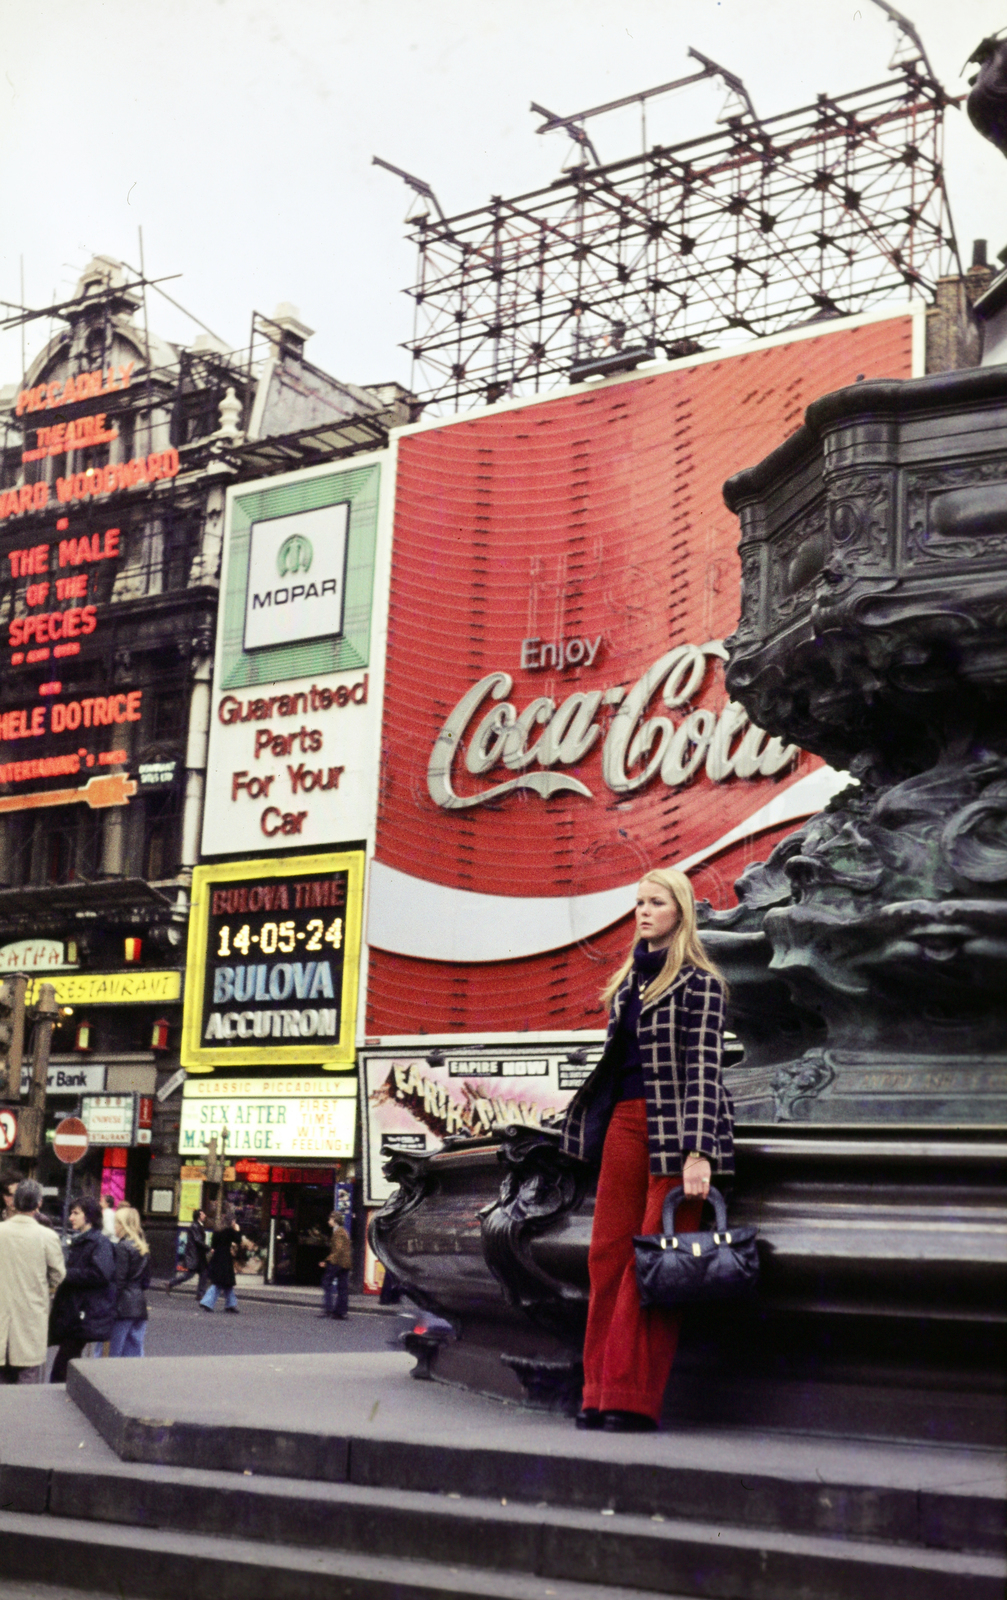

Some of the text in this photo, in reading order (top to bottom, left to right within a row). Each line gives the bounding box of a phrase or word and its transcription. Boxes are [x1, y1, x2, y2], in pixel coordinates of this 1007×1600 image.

[16, 361, 134, 416] PICCADILLY
[36, 413, 107, 449] THEATRE
[56, 448, 179, 504] WOODWARD
[8, 528, 120, 578] THE MALE
[26, 573, 88, 607] OF THE
[251, 578, 338, 609] MOPAR
[8, 605, 97, 647] SPECIES
[519, 634, 601, 670] Enjoy
[51, 690, 142, 733] DOTRICE
[218, 673, 369, 725] Guaranteed
[427, 640, 800, 808] Coca-Cola
[255, 726, 323, 759] Parts
[231, 762, 345, 801] For Your
[260, 806, 308, 837] Car
[212, 880, 346, 916] BULOVA TIME
[56, 976, 174, 999] RESTAURANT
[213, 960, 335, 1004] BULOVA
[204, 1007, 337, 1040] ACCUTRON
[57, 1071, 87, 1087] Bank
[450, 1061, 498, 1074] EMPIRE
[502, 1060, 548, 1076] NOW
[198, 1082, 340, 1093] CLASSIC PICCADILLY
[201, 1105, 230, 1124] SEX
[234, 1105, 287, 1124] AFTER
[299, 1100, 339, 1112] FIRST
[302, 1113, 333, 1125] TIME
[292, 1138, 342, 1151] FEELING
[297, 1126, 336, 1137] WITH
